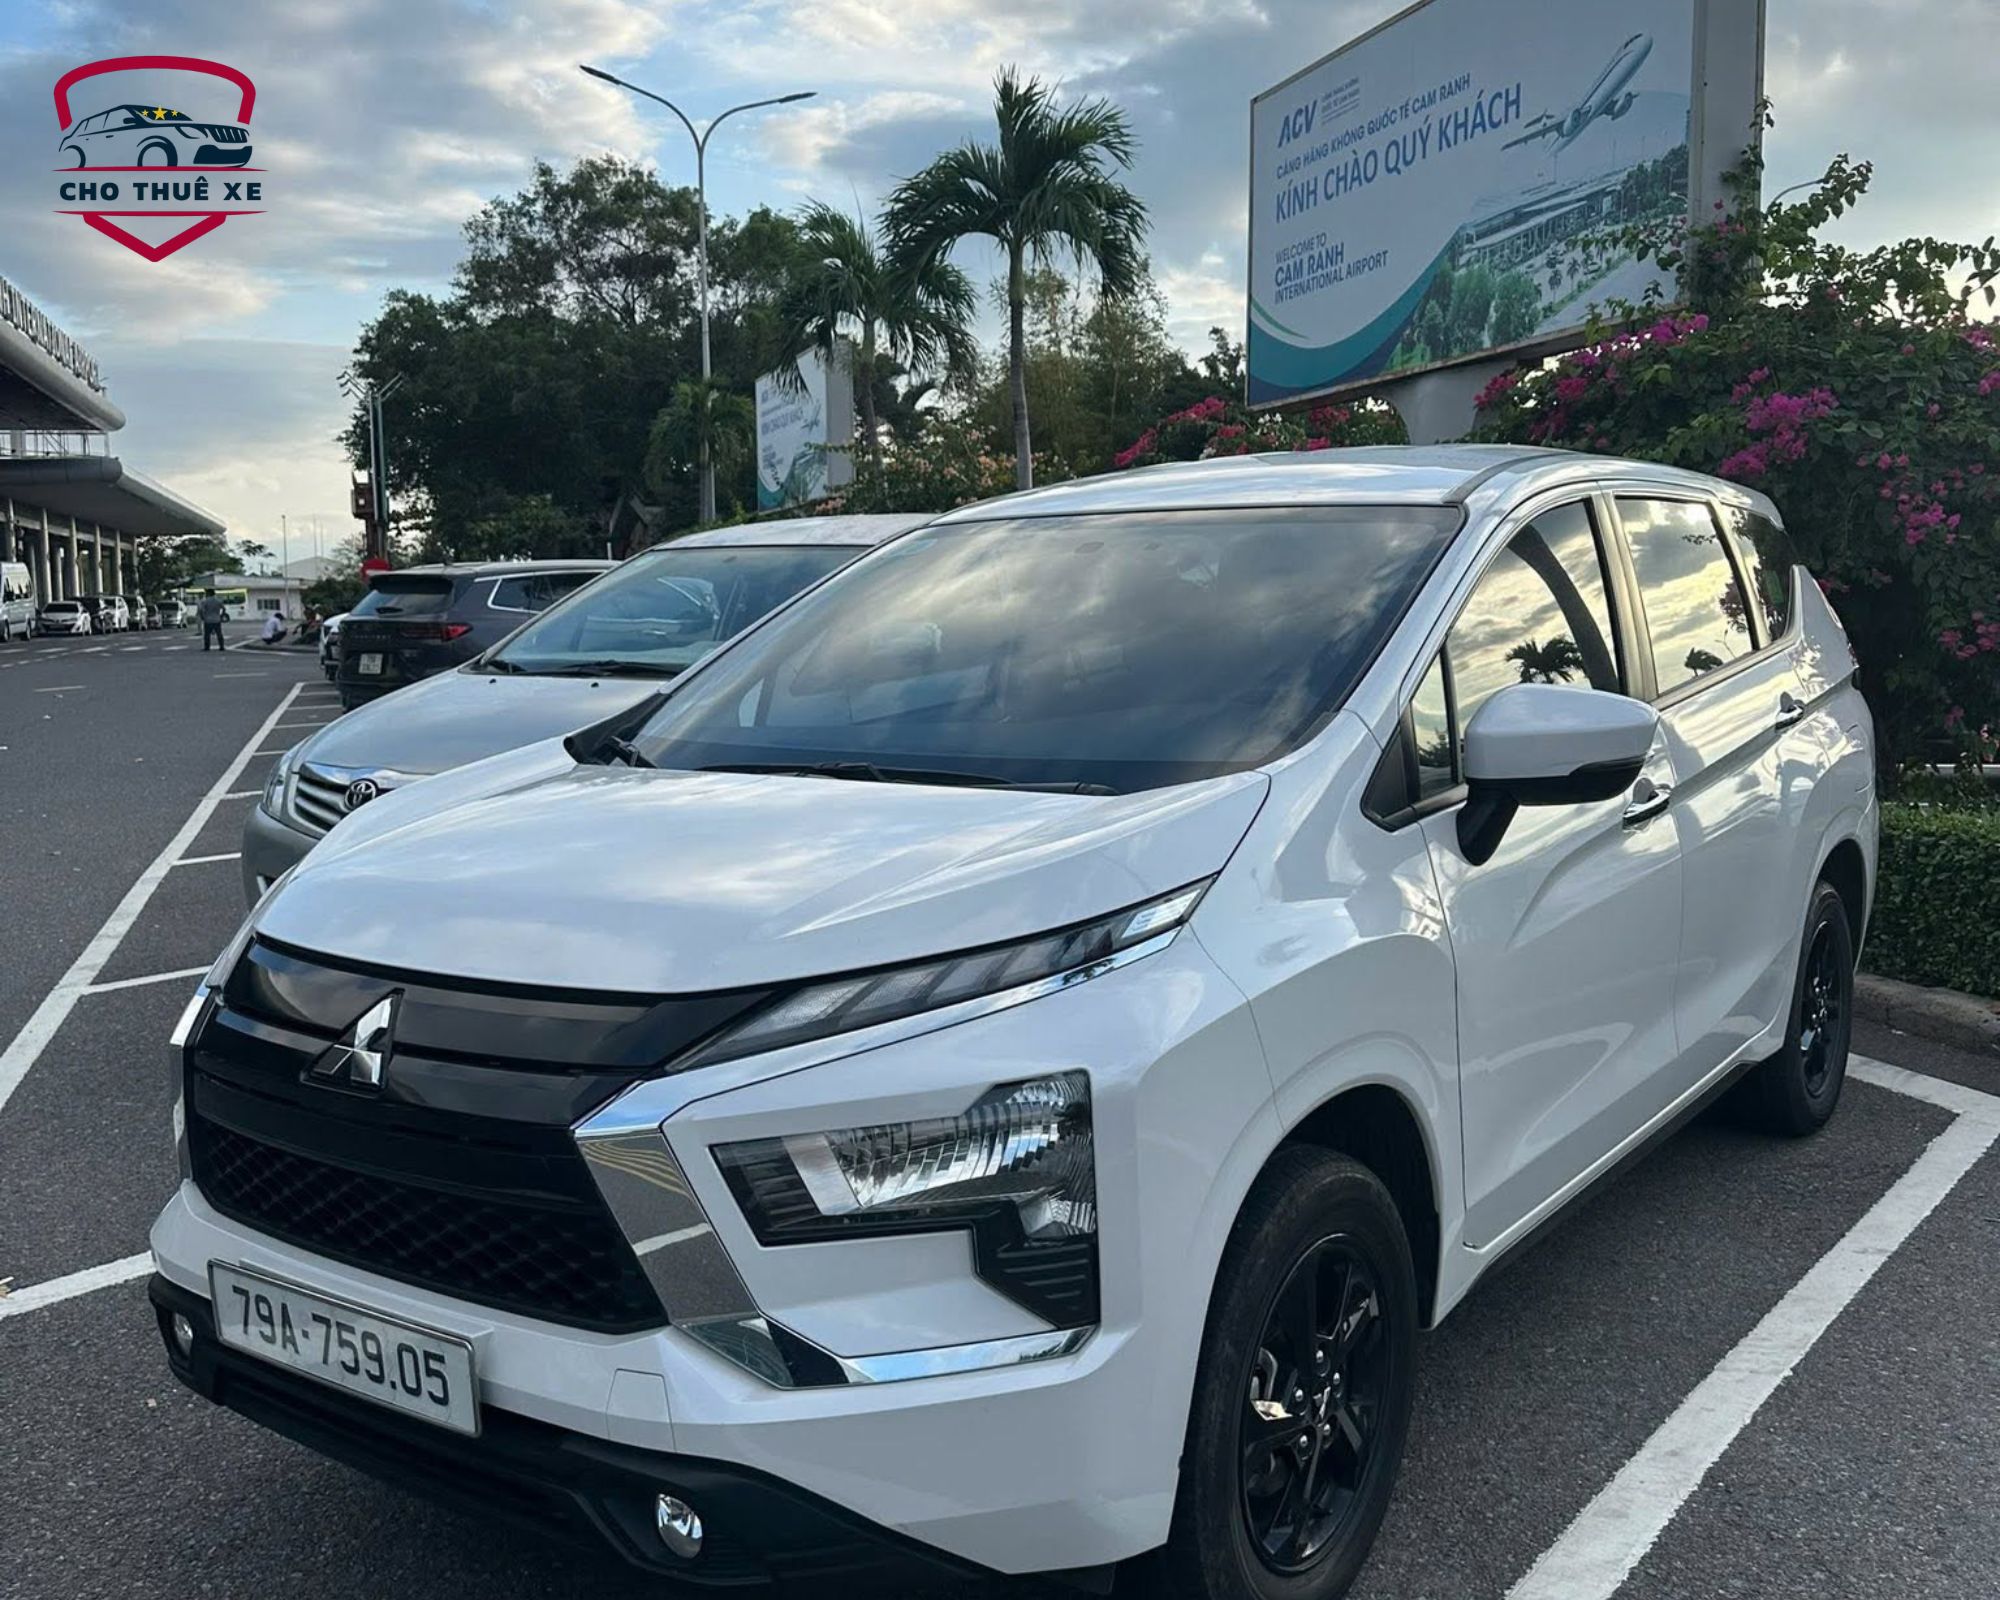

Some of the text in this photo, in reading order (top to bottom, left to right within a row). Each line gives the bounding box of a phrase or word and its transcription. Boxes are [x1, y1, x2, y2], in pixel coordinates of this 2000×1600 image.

[1412, 89, 1437, 114] CAM
[1439, 72, 1471, 102] RANH
[1277, 99, 1317, 149] ACV
[1276, 178, 1318, 224] KÍNH
[1323, 149, 1378, 201] CHÀO
[1384, 114, 1432, 175] QUÝ
[1438, 82, 1521, 152] KHÁCH
[1275, 232, 1327, 264] WELCOME TO
[1275, 242, 1345, 287] CAM RANH
[1275, 250, 1388, 304] INTERNATIONAL AIRPORT
[231, 1285, 450, 1407] 79A-759.05
